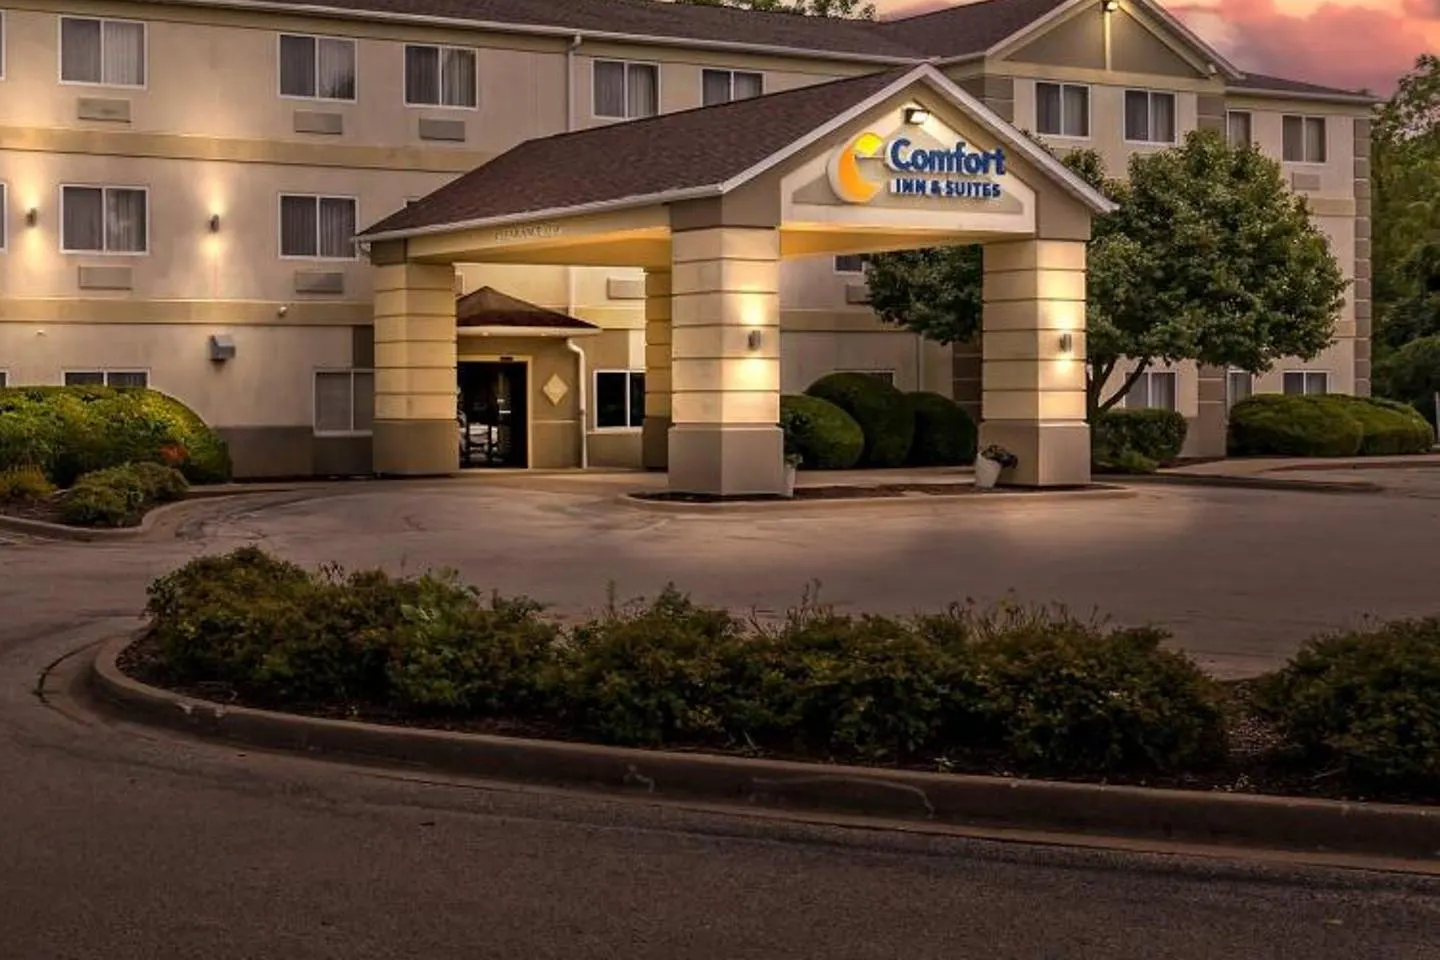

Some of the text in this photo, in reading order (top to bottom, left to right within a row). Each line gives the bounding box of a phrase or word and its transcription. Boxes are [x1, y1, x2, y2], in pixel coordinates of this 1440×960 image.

[890, 138, 1005, 175] Comfort
[896, 178, 1001, 197] INN & SUITES
